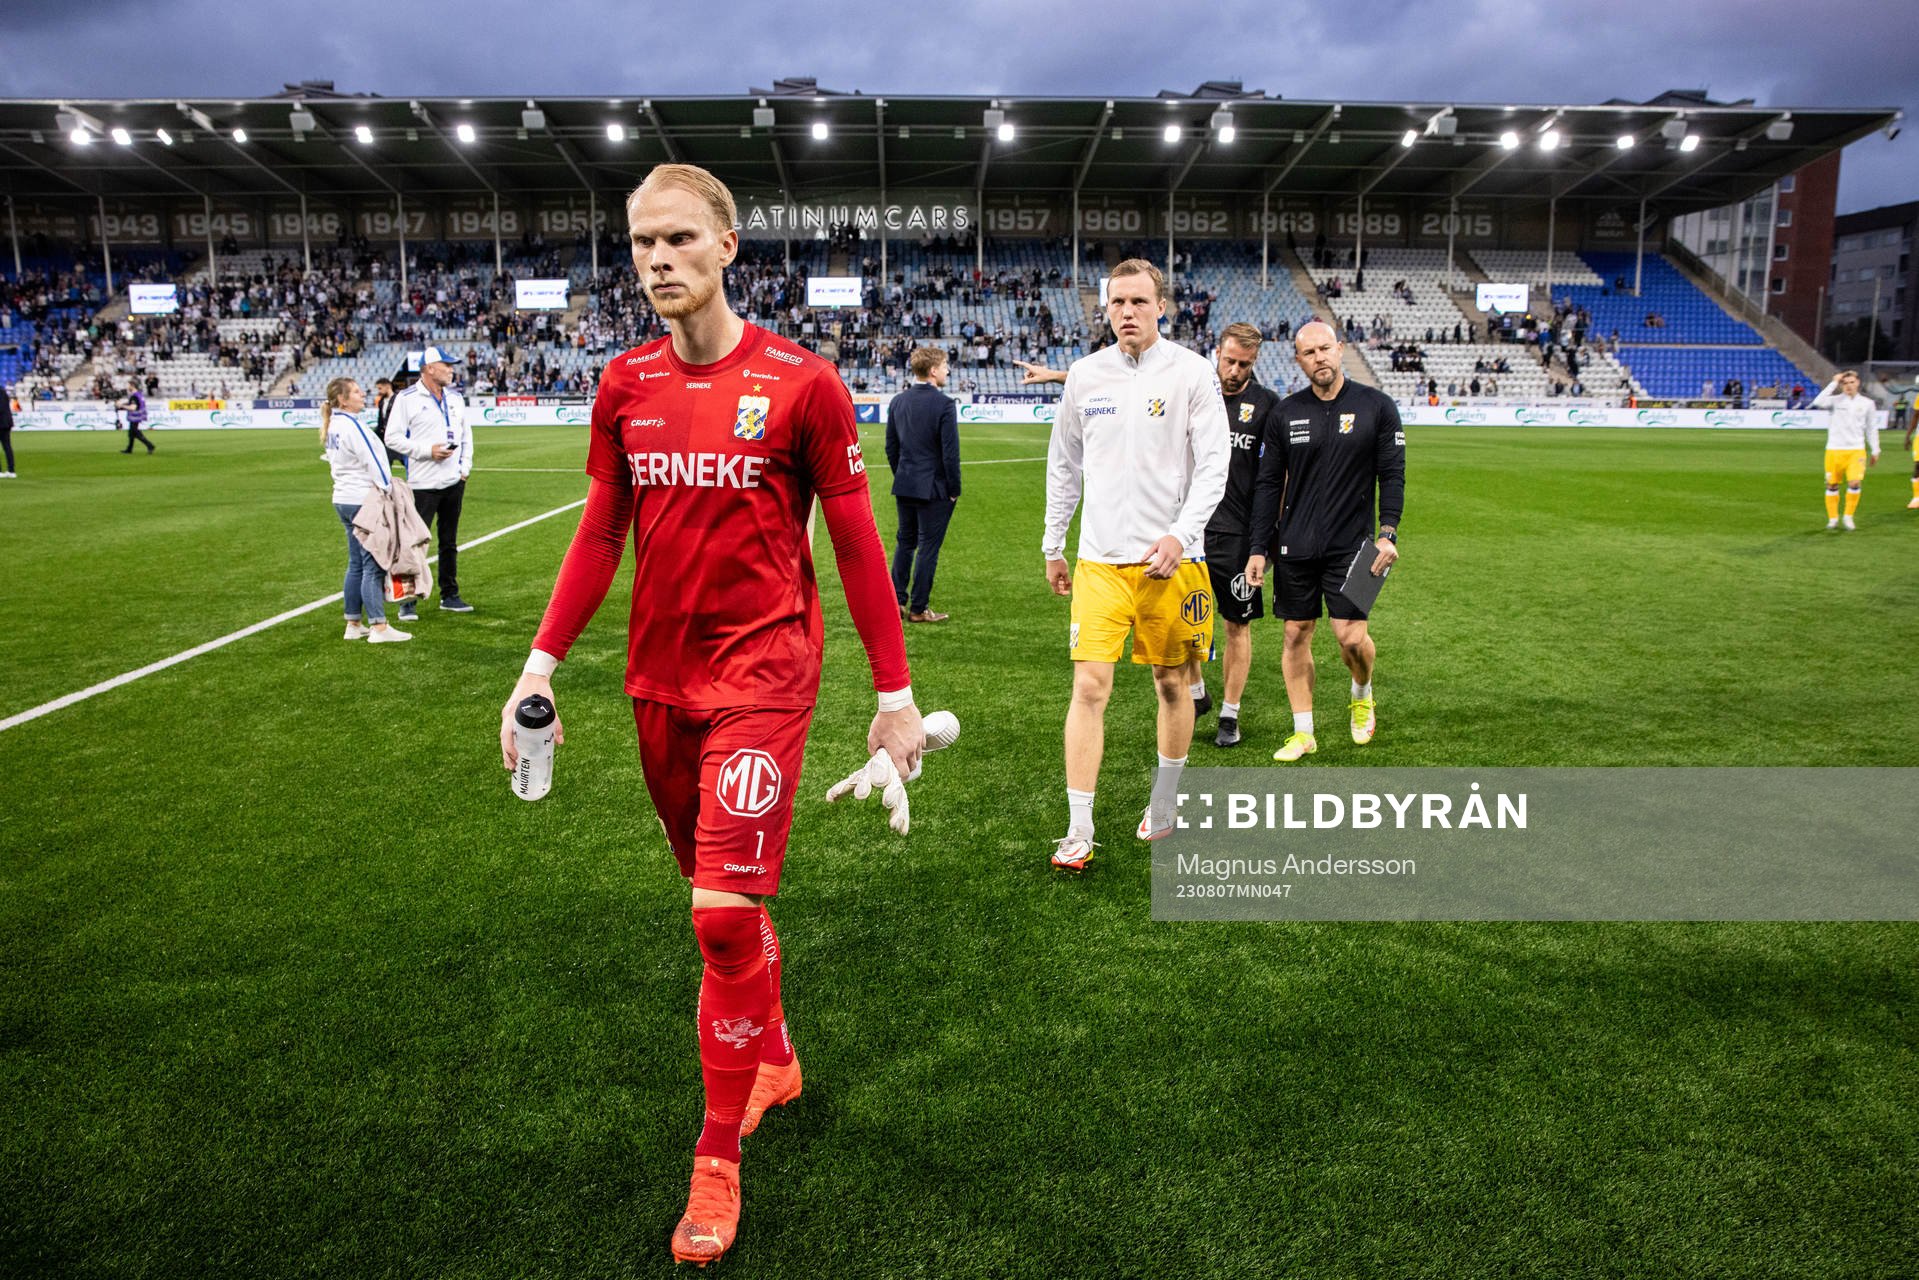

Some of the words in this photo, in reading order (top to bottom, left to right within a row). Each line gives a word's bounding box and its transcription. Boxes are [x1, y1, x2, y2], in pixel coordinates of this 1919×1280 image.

[89, 214, 160, 237] 1943
[175, 213, 250, 236] 1945
[270, 212, 341, 235] 1946
[361, 211, 428, 234] 1947
[449, 210, 519, 233] 1948
[735, 205, 970, 230] ATINUMCARS
[985, 208, 1050, 232] 1957
[1077, 208, 1142, 232] 1960
[1161, 210, 1229, 233] 1962
[1248, 211, 1316, 234] 1963
[1335, 213, 1401, 236] 1989
[1421, 213, 1492, 237] 2015
[764, 346, 804, 365] FAMECO
[282, 411, 321, 426] Carlsber
[556, 407, 592, 422] Carlsber
[631, 418, 658, 427] CRAFT
[961, 405, 1004, 420] Carlsberg
[1084, 406, 1117, 416] SERNEKE
[1183, 590, 1211, 624] MG
[1192, 632, 1205, 648] 21
[520, 757, 530, 795] MAURTEN
[720, 753, 778, 813] MG
[756, 831, 764, 859] 1
[724, 863, 758, 873] CRAFT
